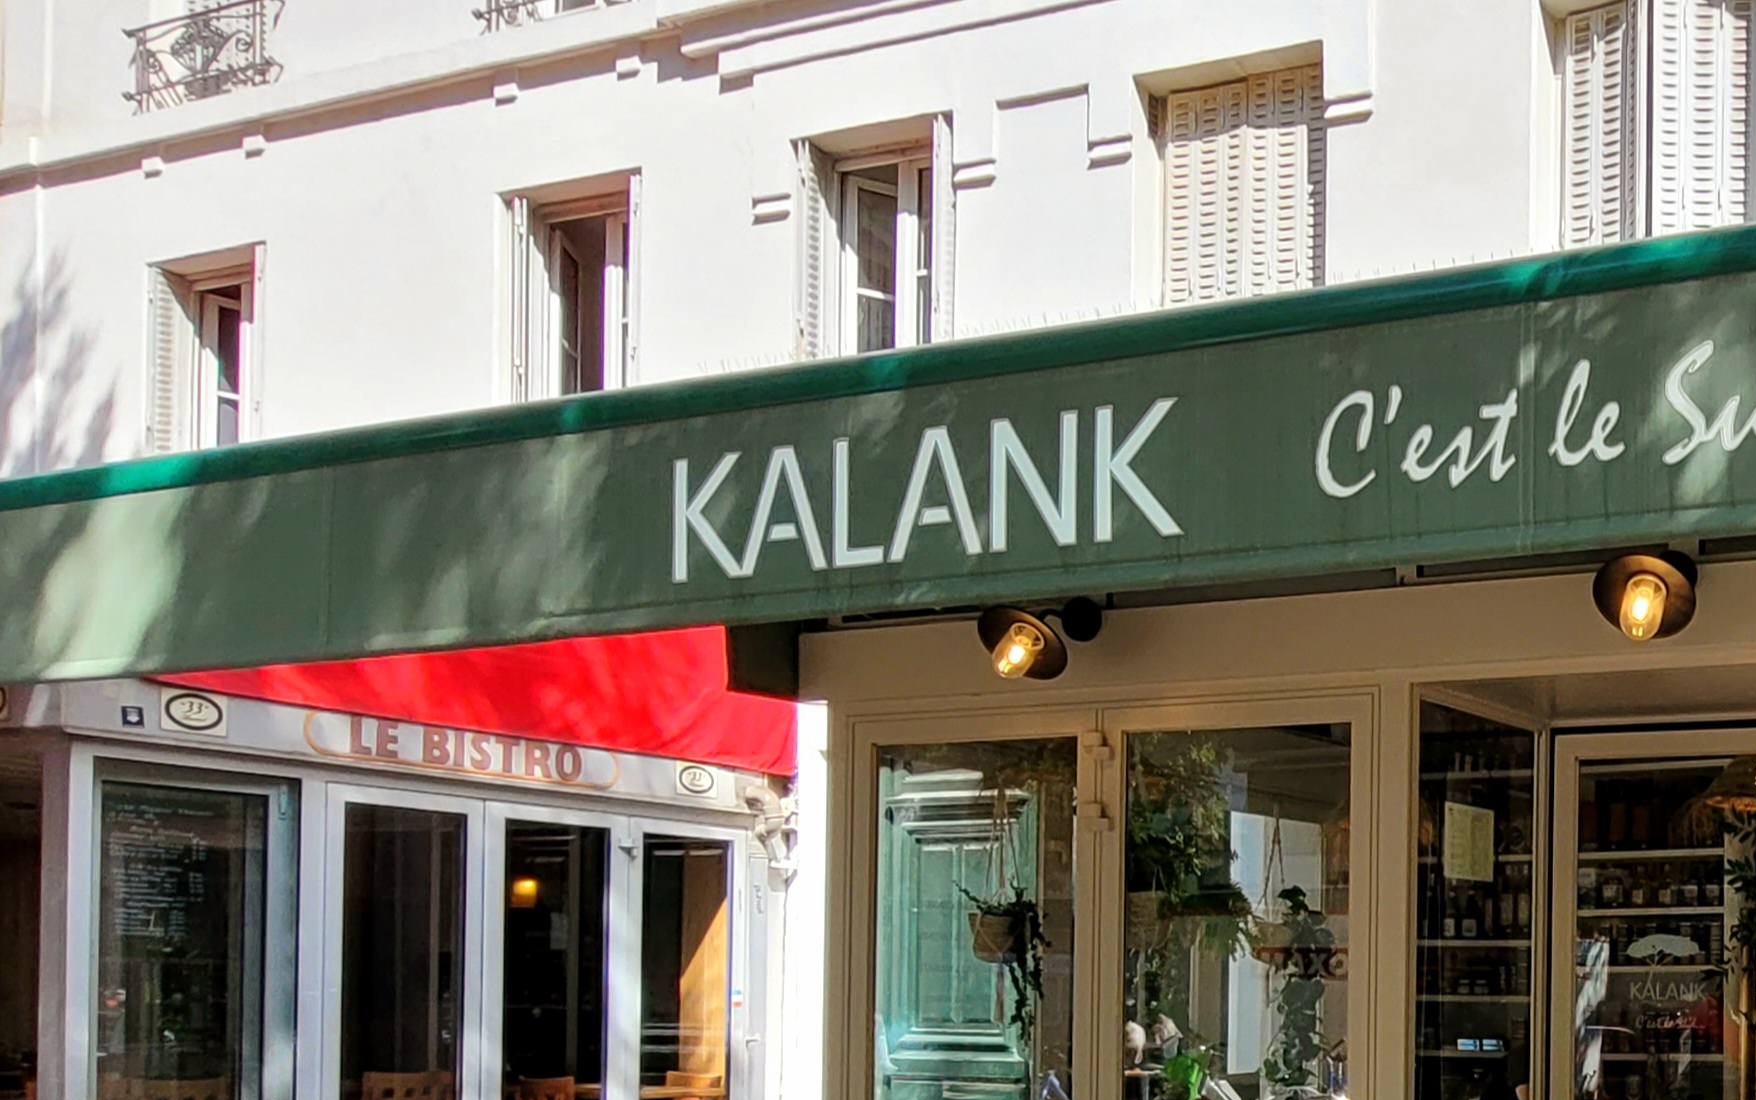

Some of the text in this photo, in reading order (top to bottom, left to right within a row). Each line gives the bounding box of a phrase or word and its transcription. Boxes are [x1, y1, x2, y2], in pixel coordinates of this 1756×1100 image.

[1315, 384, 1518, 498] C'est
[1547, 358, 1626, 467] le
[672, 397, 1184, 585] KALANK
[349, 715, 583, 782] LE BISTRO
[1630, 981, 1707, 1001] KALANK
